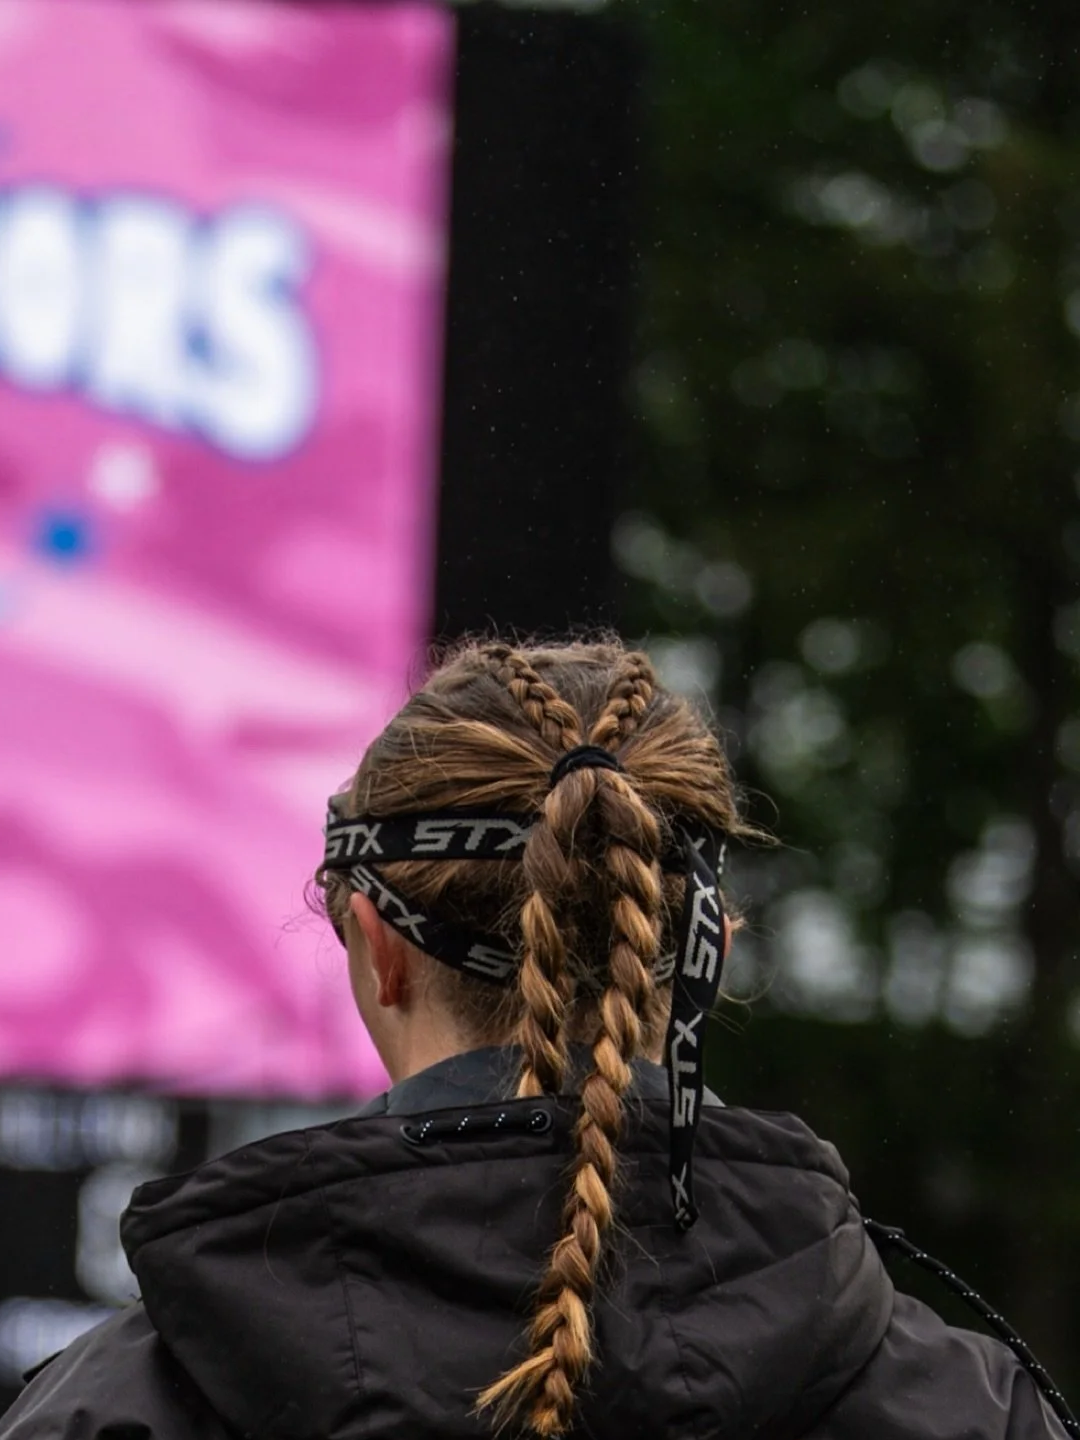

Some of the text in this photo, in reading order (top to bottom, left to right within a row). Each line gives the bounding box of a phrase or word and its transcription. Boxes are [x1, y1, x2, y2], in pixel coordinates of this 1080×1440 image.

[326, 819, 532, 858] STX STX
[350, 864, 427, 945] STX
[682, 871, 720, 984] STX
[671, 1011, 704, 1128] STX
